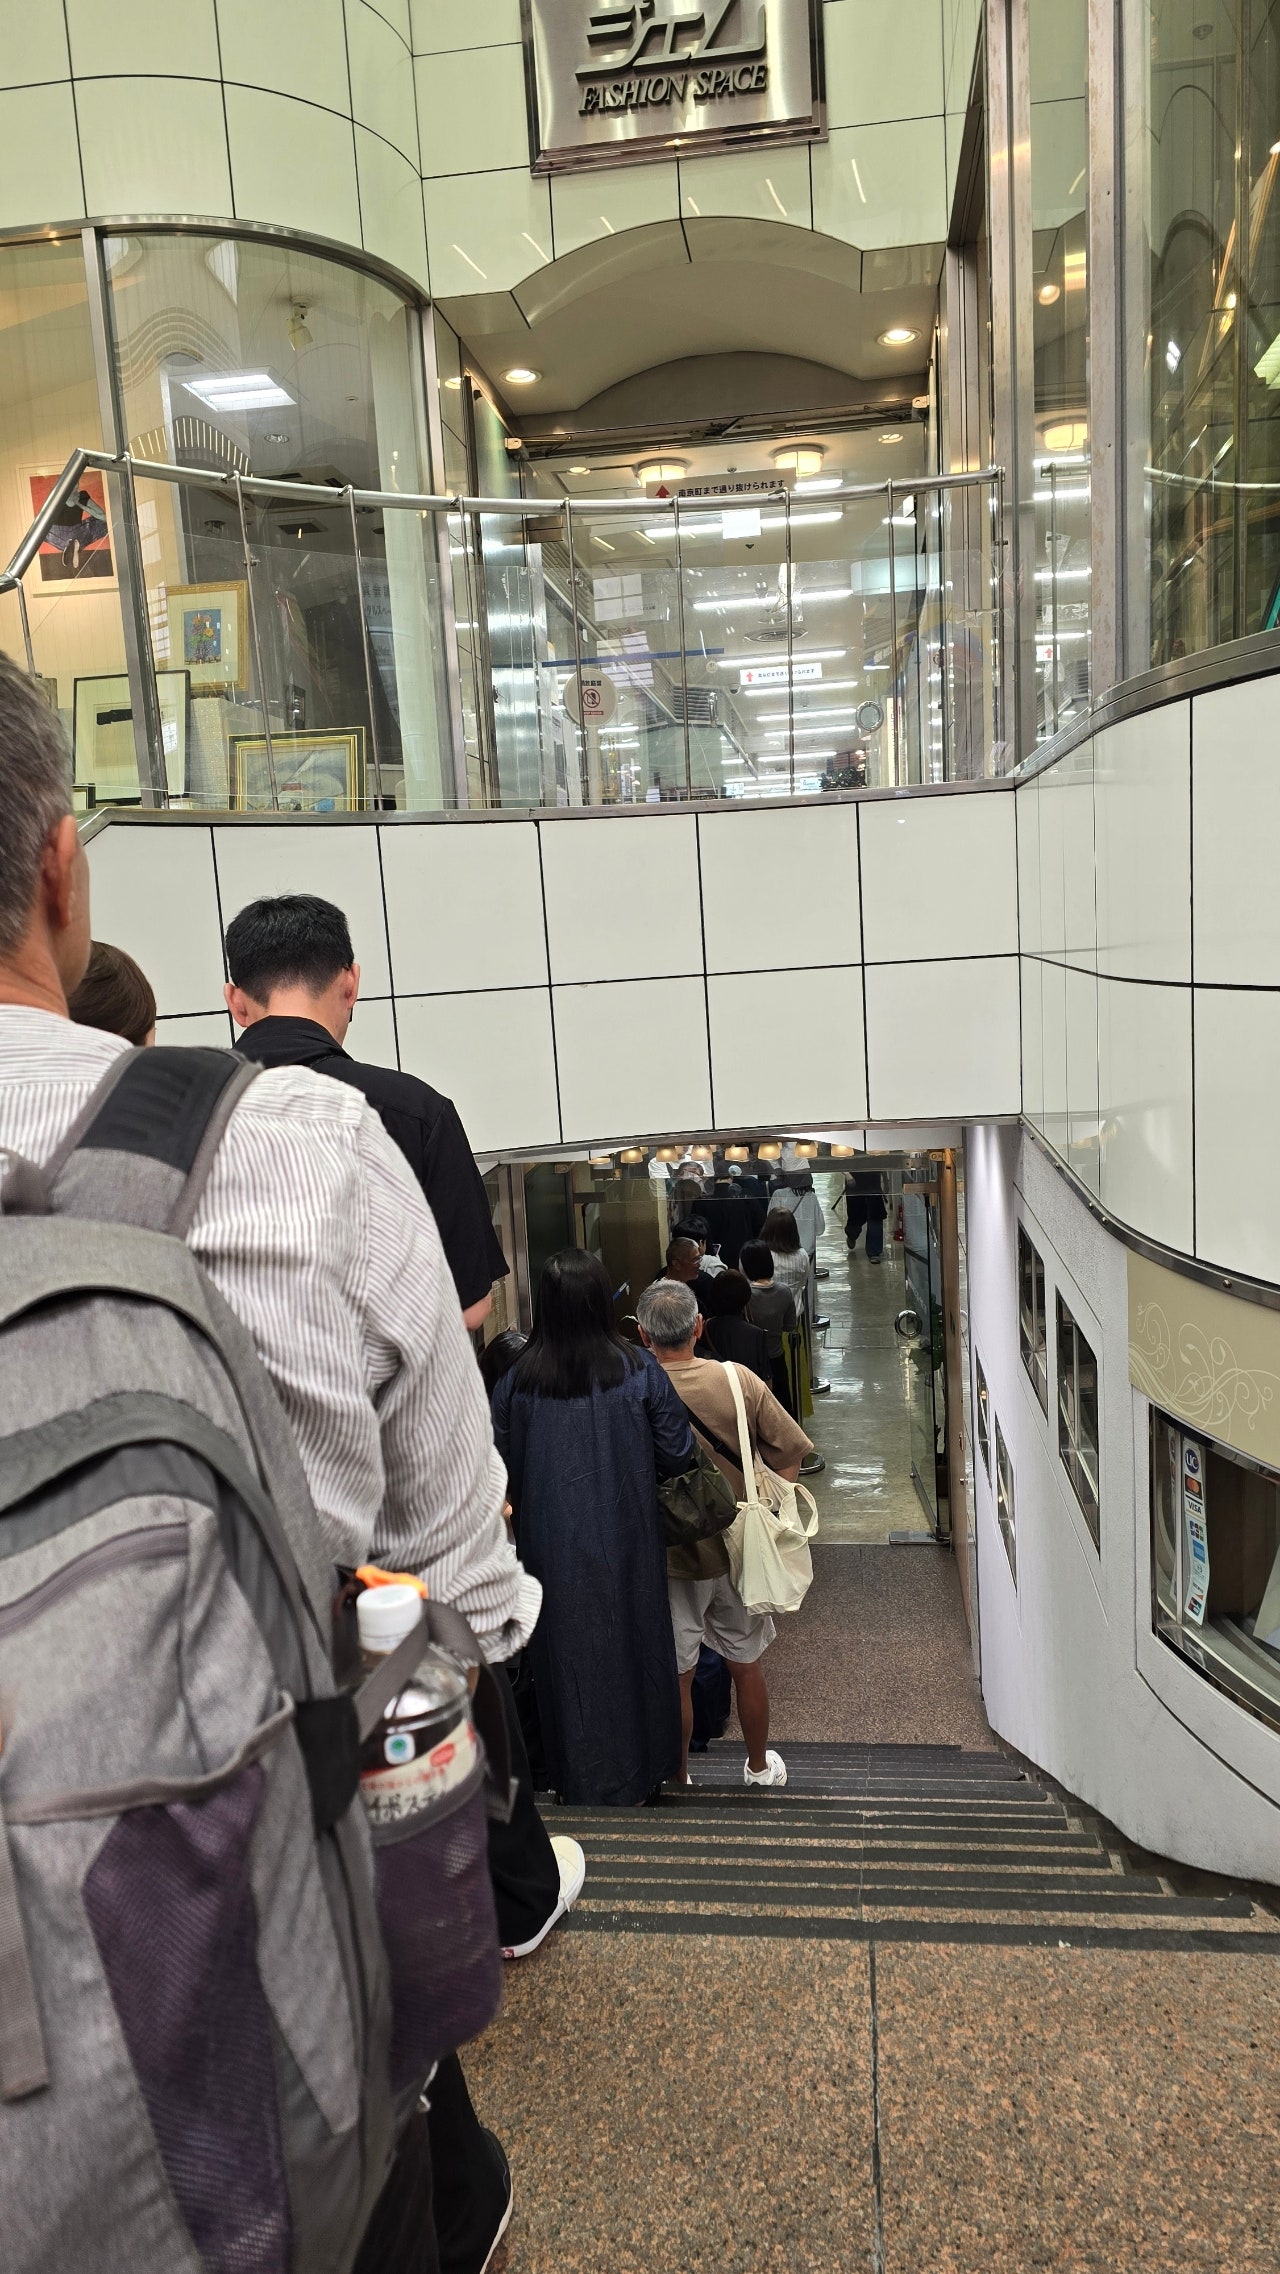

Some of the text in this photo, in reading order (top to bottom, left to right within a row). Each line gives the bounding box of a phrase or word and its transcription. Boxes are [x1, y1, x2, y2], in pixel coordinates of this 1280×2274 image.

[580, 65, 767, 112] FASHION SPACE
[678, 479, 785, 497] 南京町まで通り抜けられます
[1185, 1452, 1199, 1470] UC
[1188, 1500, 1202, 1514] VISA
